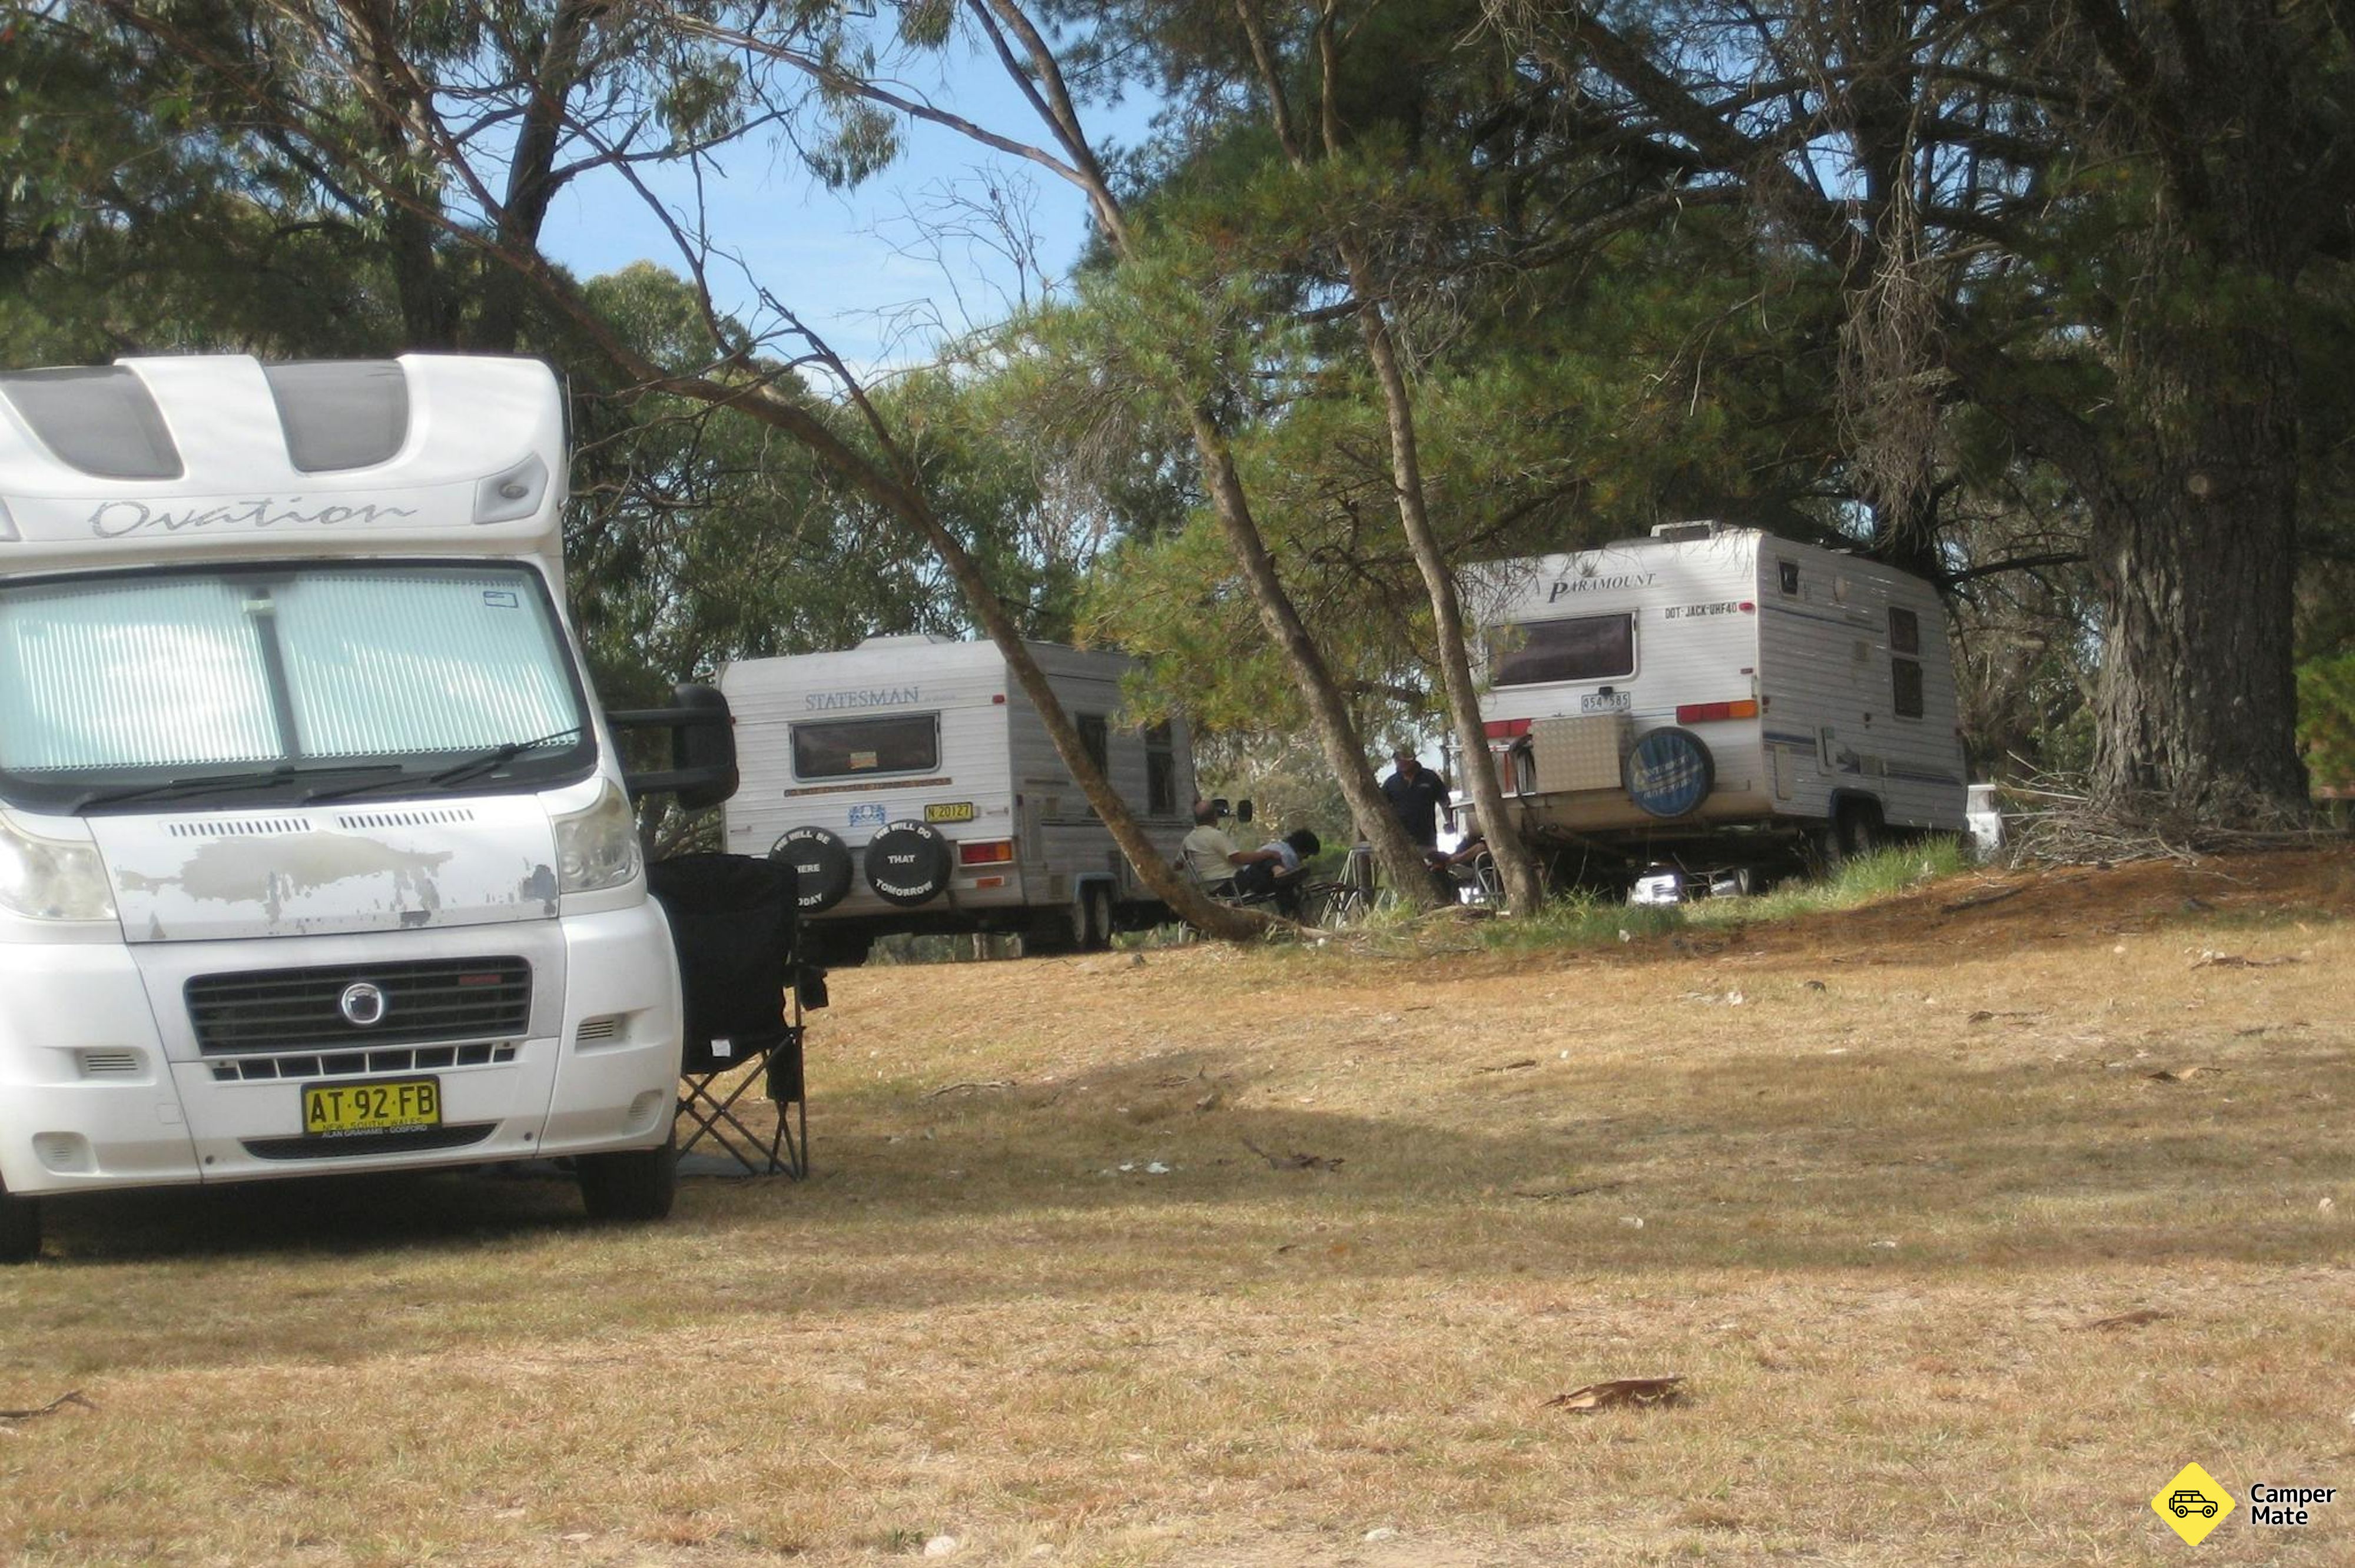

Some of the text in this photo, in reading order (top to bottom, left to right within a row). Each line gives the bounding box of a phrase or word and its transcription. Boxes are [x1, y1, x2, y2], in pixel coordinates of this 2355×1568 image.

[88, 496, 417, 538] Ovation
[1548, 573, 1656, 604] PARAMOUNT
[805, 687, 918, 711] STATESMAN
[875, 822, 932, 840] WE WILL DO
[775, 830, 831, 852] WE WILL BE
[887, 855, 916, 864] THAT
[876, 878, 933, 897] TOMORROW
[798, 892, 822, 906] ODAY
[351, 1120, 383, 1129] SOUTH
[391, 1118, 423, 1127] WALES
